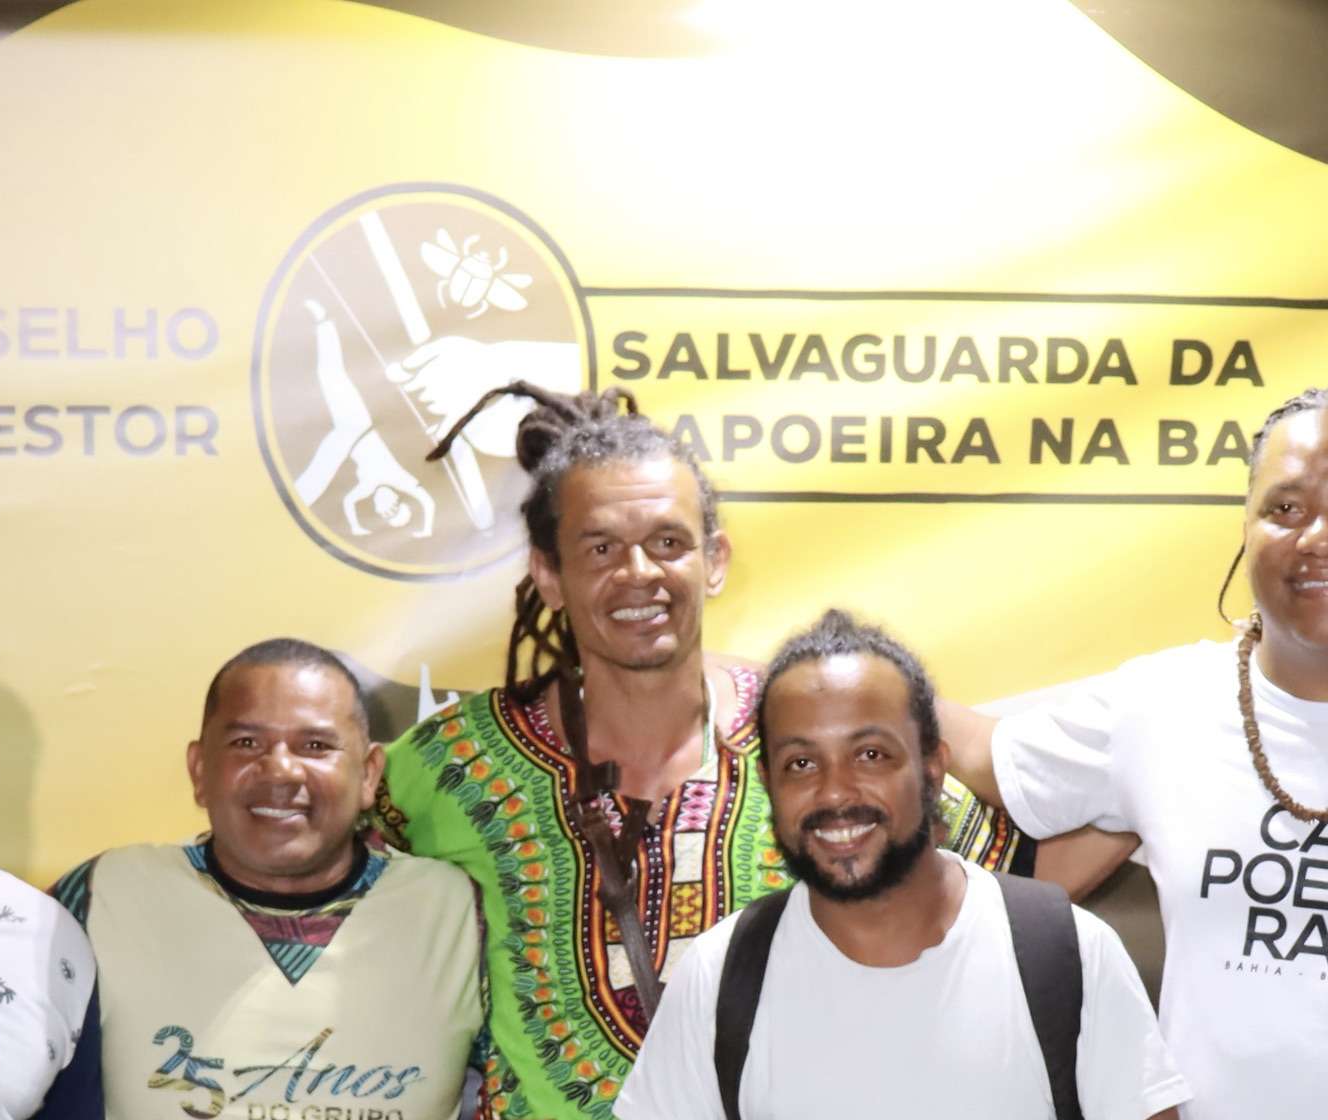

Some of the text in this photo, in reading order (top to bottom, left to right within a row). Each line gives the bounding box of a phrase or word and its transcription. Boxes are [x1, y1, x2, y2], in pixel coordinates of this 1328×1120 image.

[610, 330, 1266, 388] SALVAGUARDA DA
[672, 412, 1251, 467] APOEIRA NA BA
[1224, 960, 1282, 976] BAHIA
[146, 1023, 427, 1120] 25 Anos
